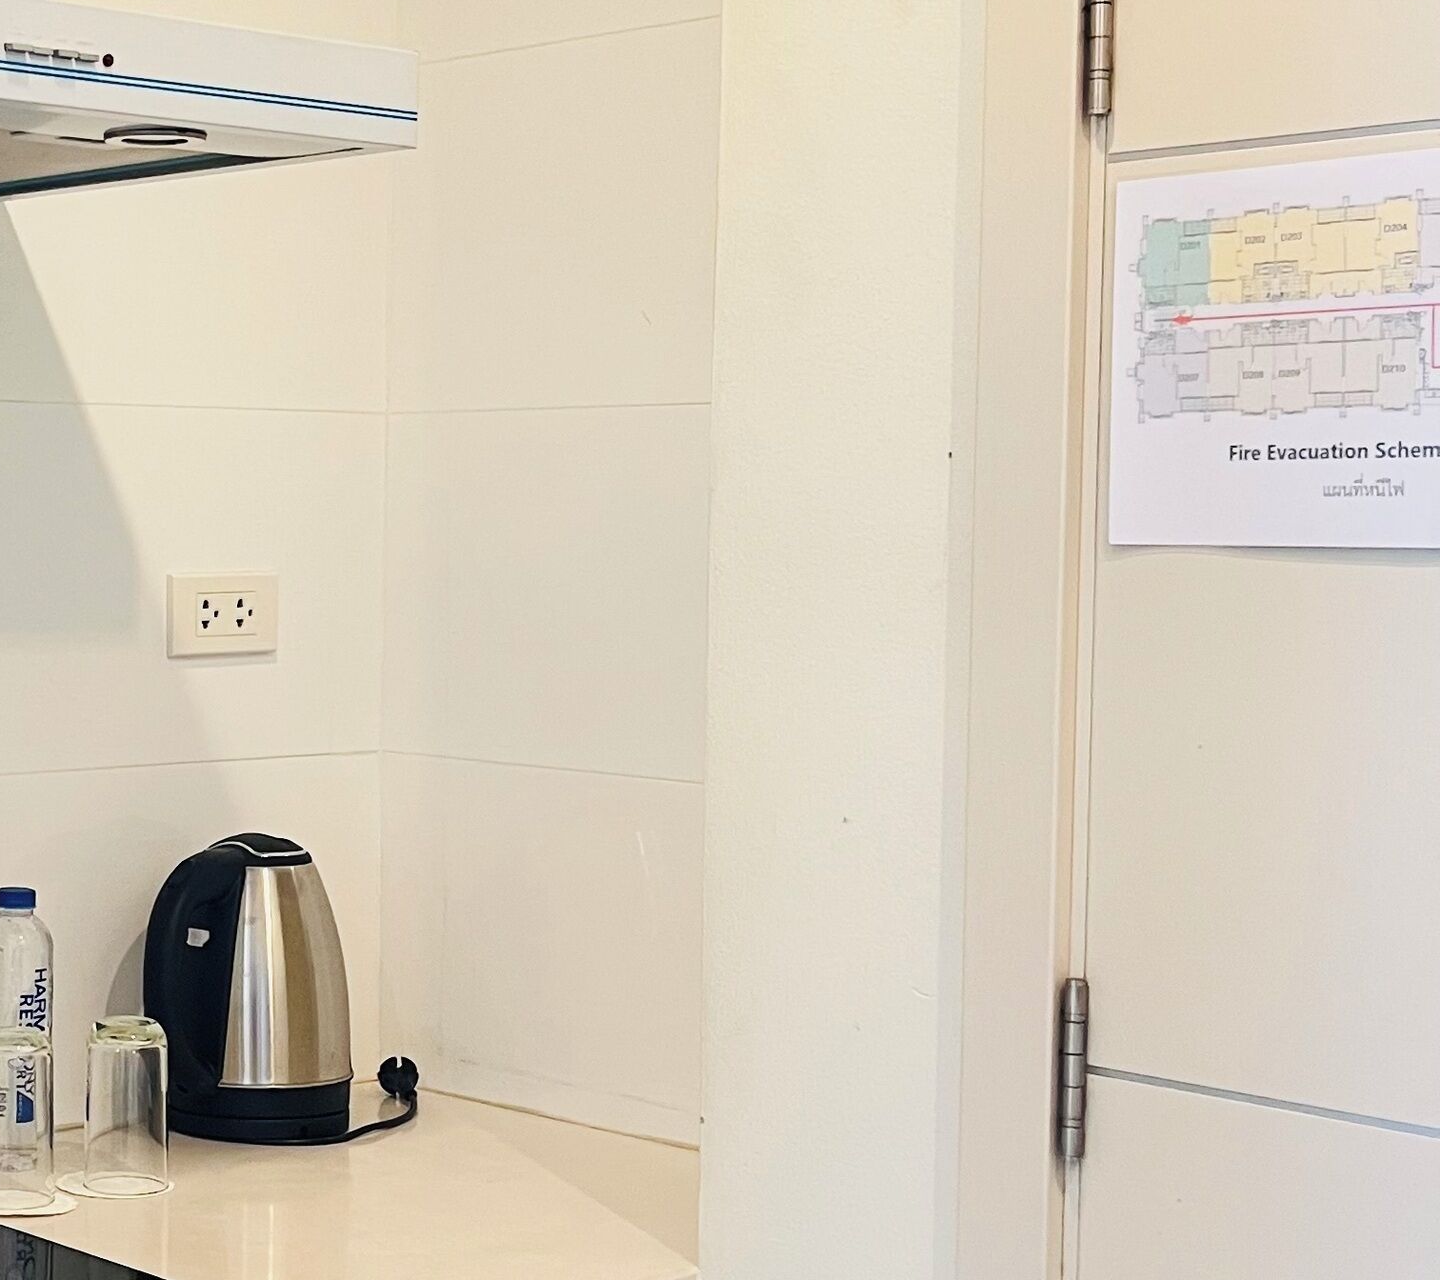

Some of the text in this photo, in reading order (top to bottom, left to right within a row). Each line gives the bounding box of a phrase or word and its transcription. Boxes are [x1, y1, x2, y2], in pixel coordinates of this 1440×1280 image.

[1383, 223, 1408, 234] D204
[1229, 444, 1261, 462] Fire
[1267, 442, 1369, 461] Evacuation
